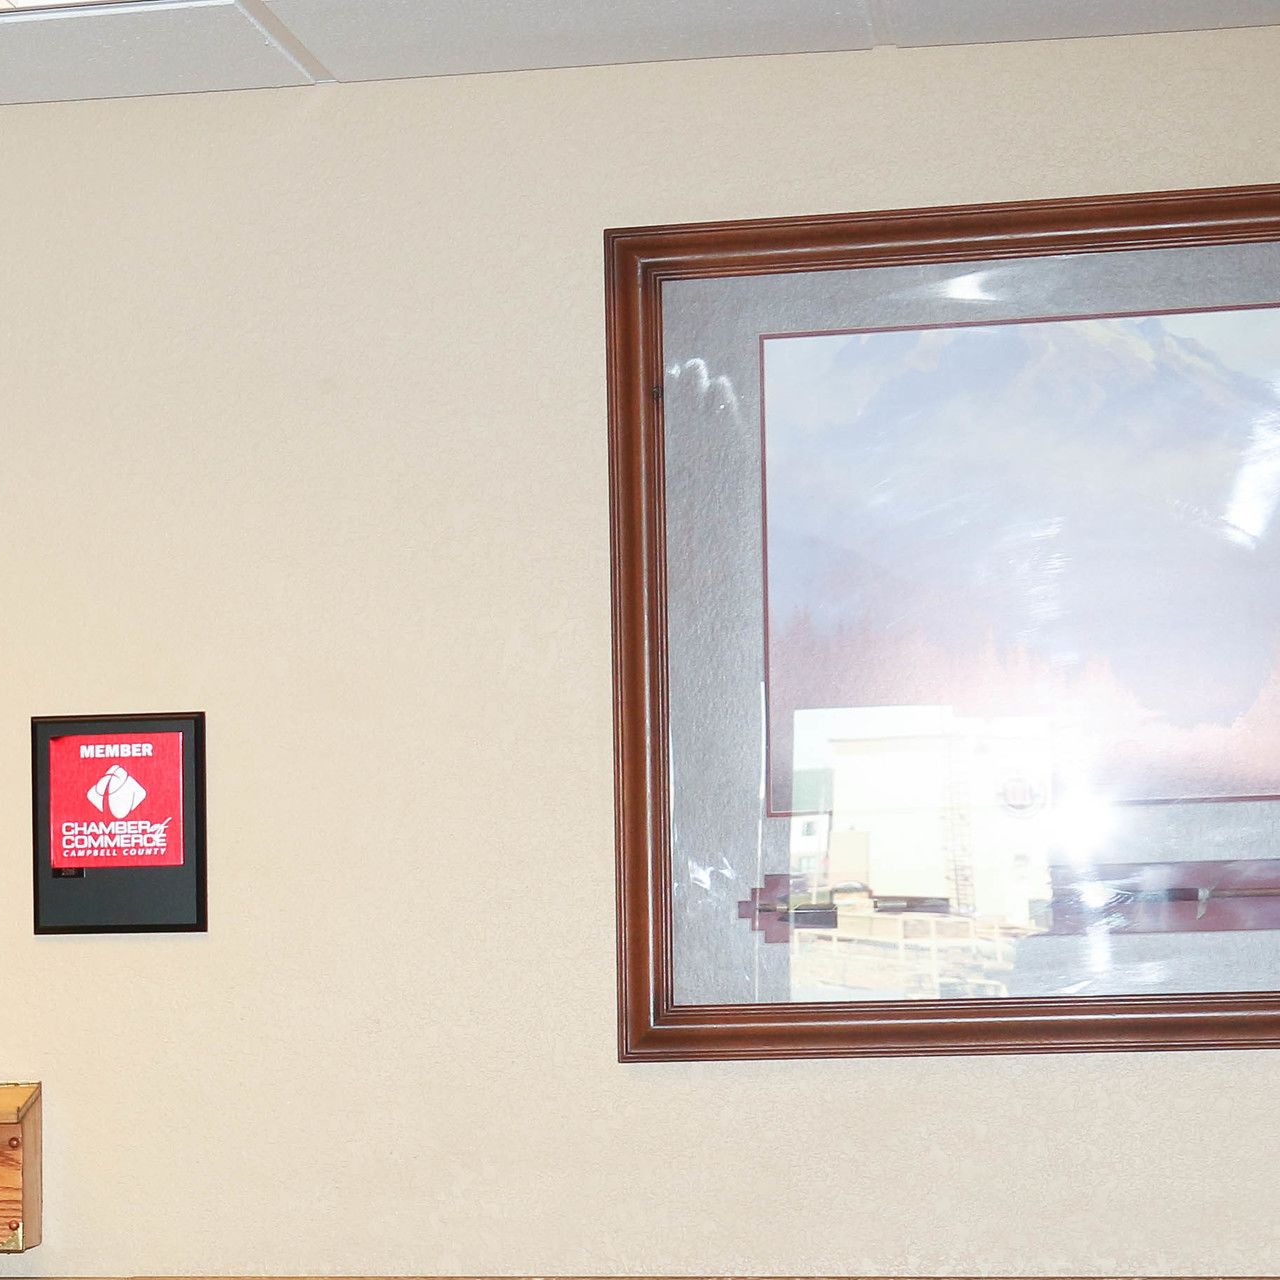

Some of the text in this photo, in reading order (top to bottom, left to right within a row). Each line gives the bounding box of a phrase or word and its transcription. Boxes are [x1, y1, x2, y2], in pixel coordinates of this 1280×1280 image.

[80, 743, 153, 759] MEMBER
[62, 820, 151, 835] CHAMBER
[62, 833, 167, 849] COMMERCE
[63, 847, 166, 857] CAMPBELL COUNTY
